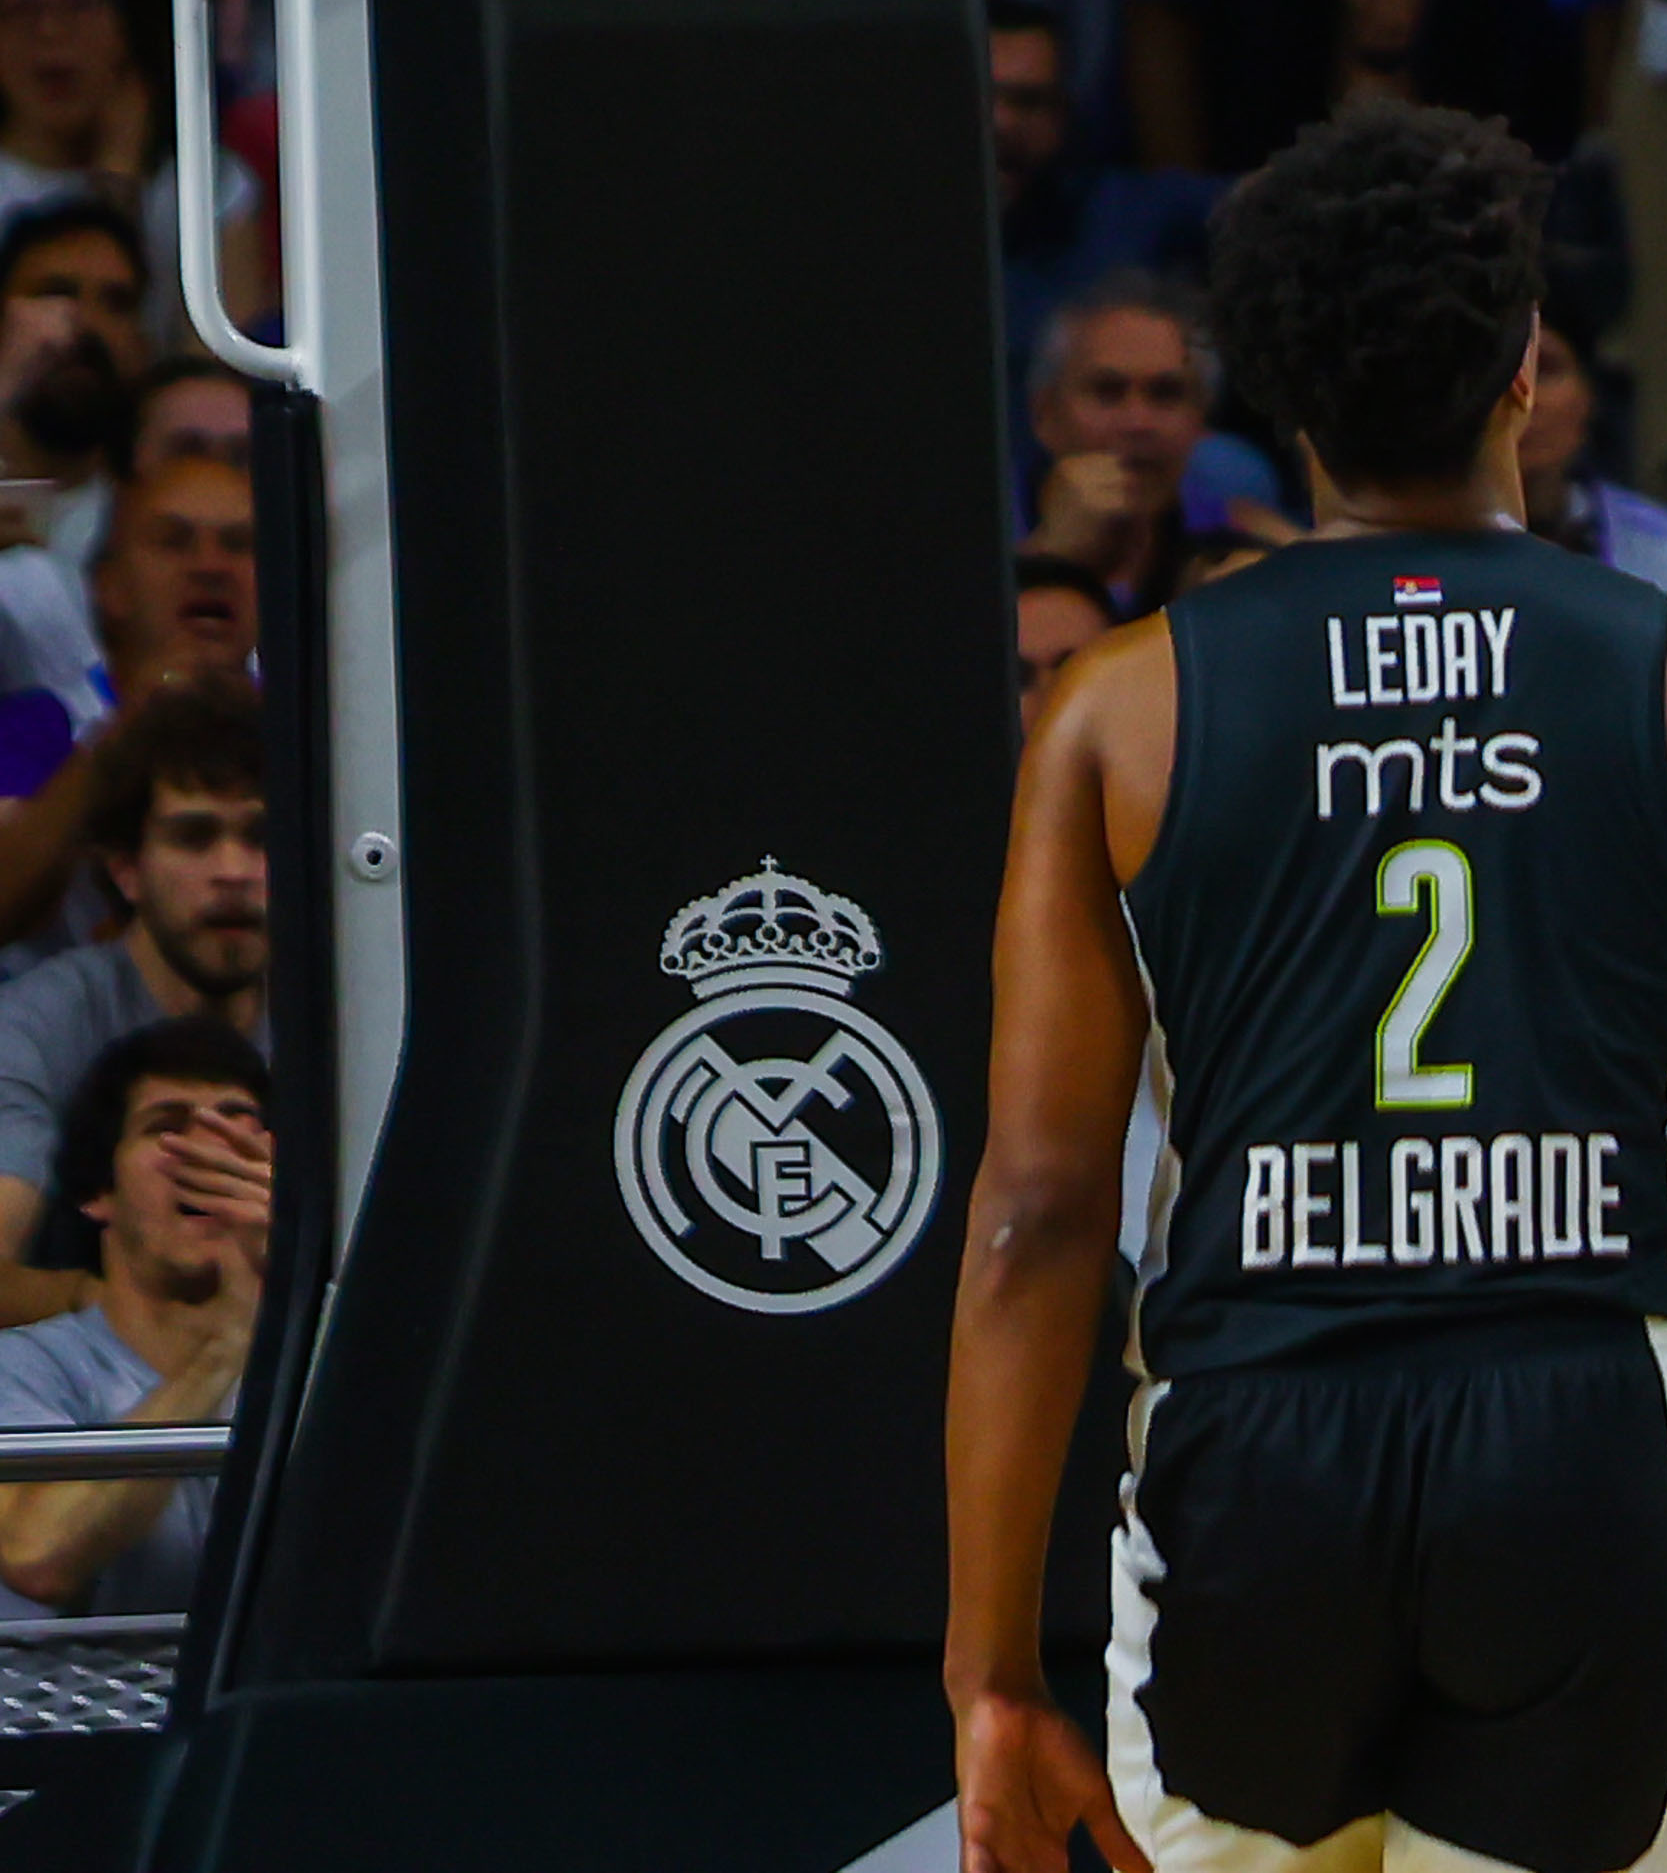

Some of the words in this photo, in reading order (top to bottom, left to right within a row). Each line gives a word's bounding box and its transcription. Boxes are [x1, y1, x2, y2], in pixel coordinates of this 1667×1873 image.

[1326, 607, 1516, 708] LEDAY
[1316, 715, 1544, 821] mts
[1376, 837, 1475, 1112] 2
[1241, 1132, 1631, 1271] BELGRADE
